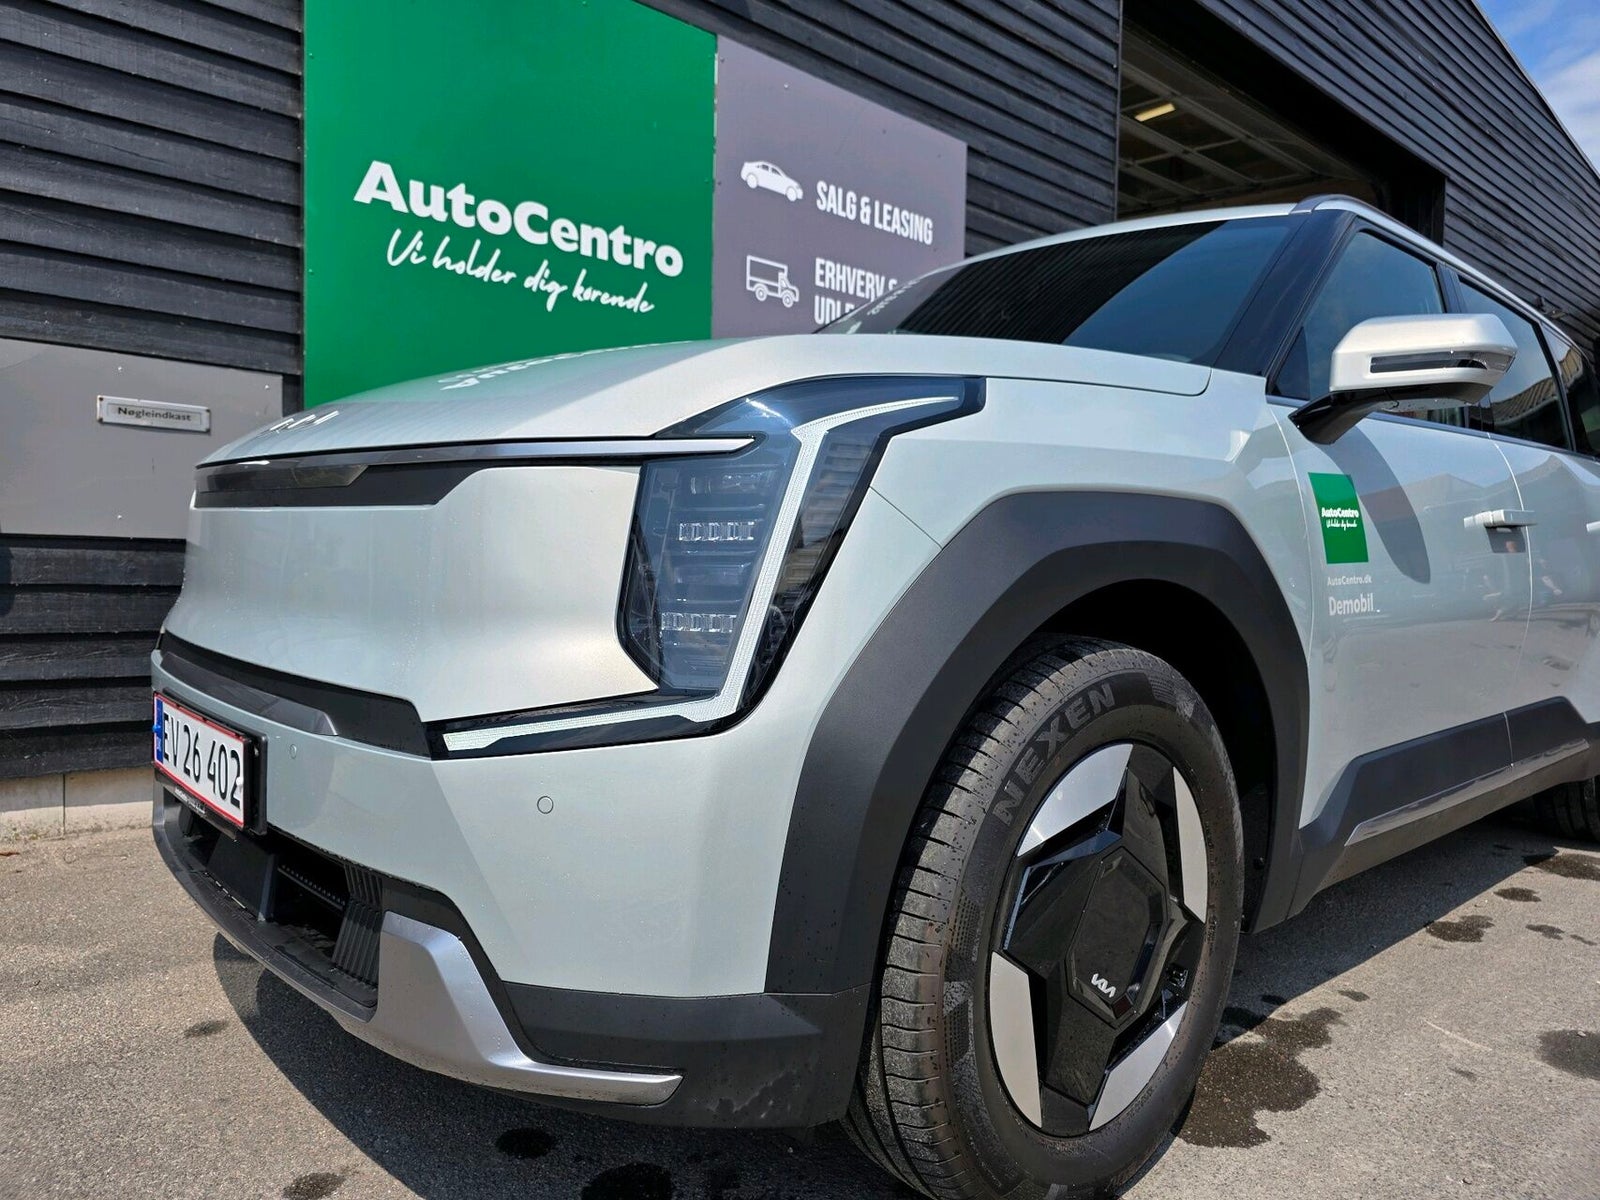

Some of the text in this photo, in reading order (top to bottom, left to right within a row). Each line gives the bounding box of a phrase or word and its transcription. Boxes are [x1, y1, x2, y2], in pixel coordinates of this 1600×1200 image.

[353, 160, 684, 277] AutoCentro
[816, 181, 933, 245] SALG & LEASING
[387, 228, 426, 266] Vi
[432, 236, 517, 282] holder
[524, 260, 568, 312] dig
[815, 257, 885, 302] ERHVERV
[117, 407, 191, 421] Nøgleindkast
[1321, 507, 1359, 518] AutoCentro
[1327, 575, 1372, 587] AutoCentro.dk
[1328, 592, 1374, 616] Demobil
[164, 712, 179, 767] EV
[183, 724, 201, 783] 26
[207, 740, 241, 810] 402
[992, 683, 1115, 825] NEXEN
